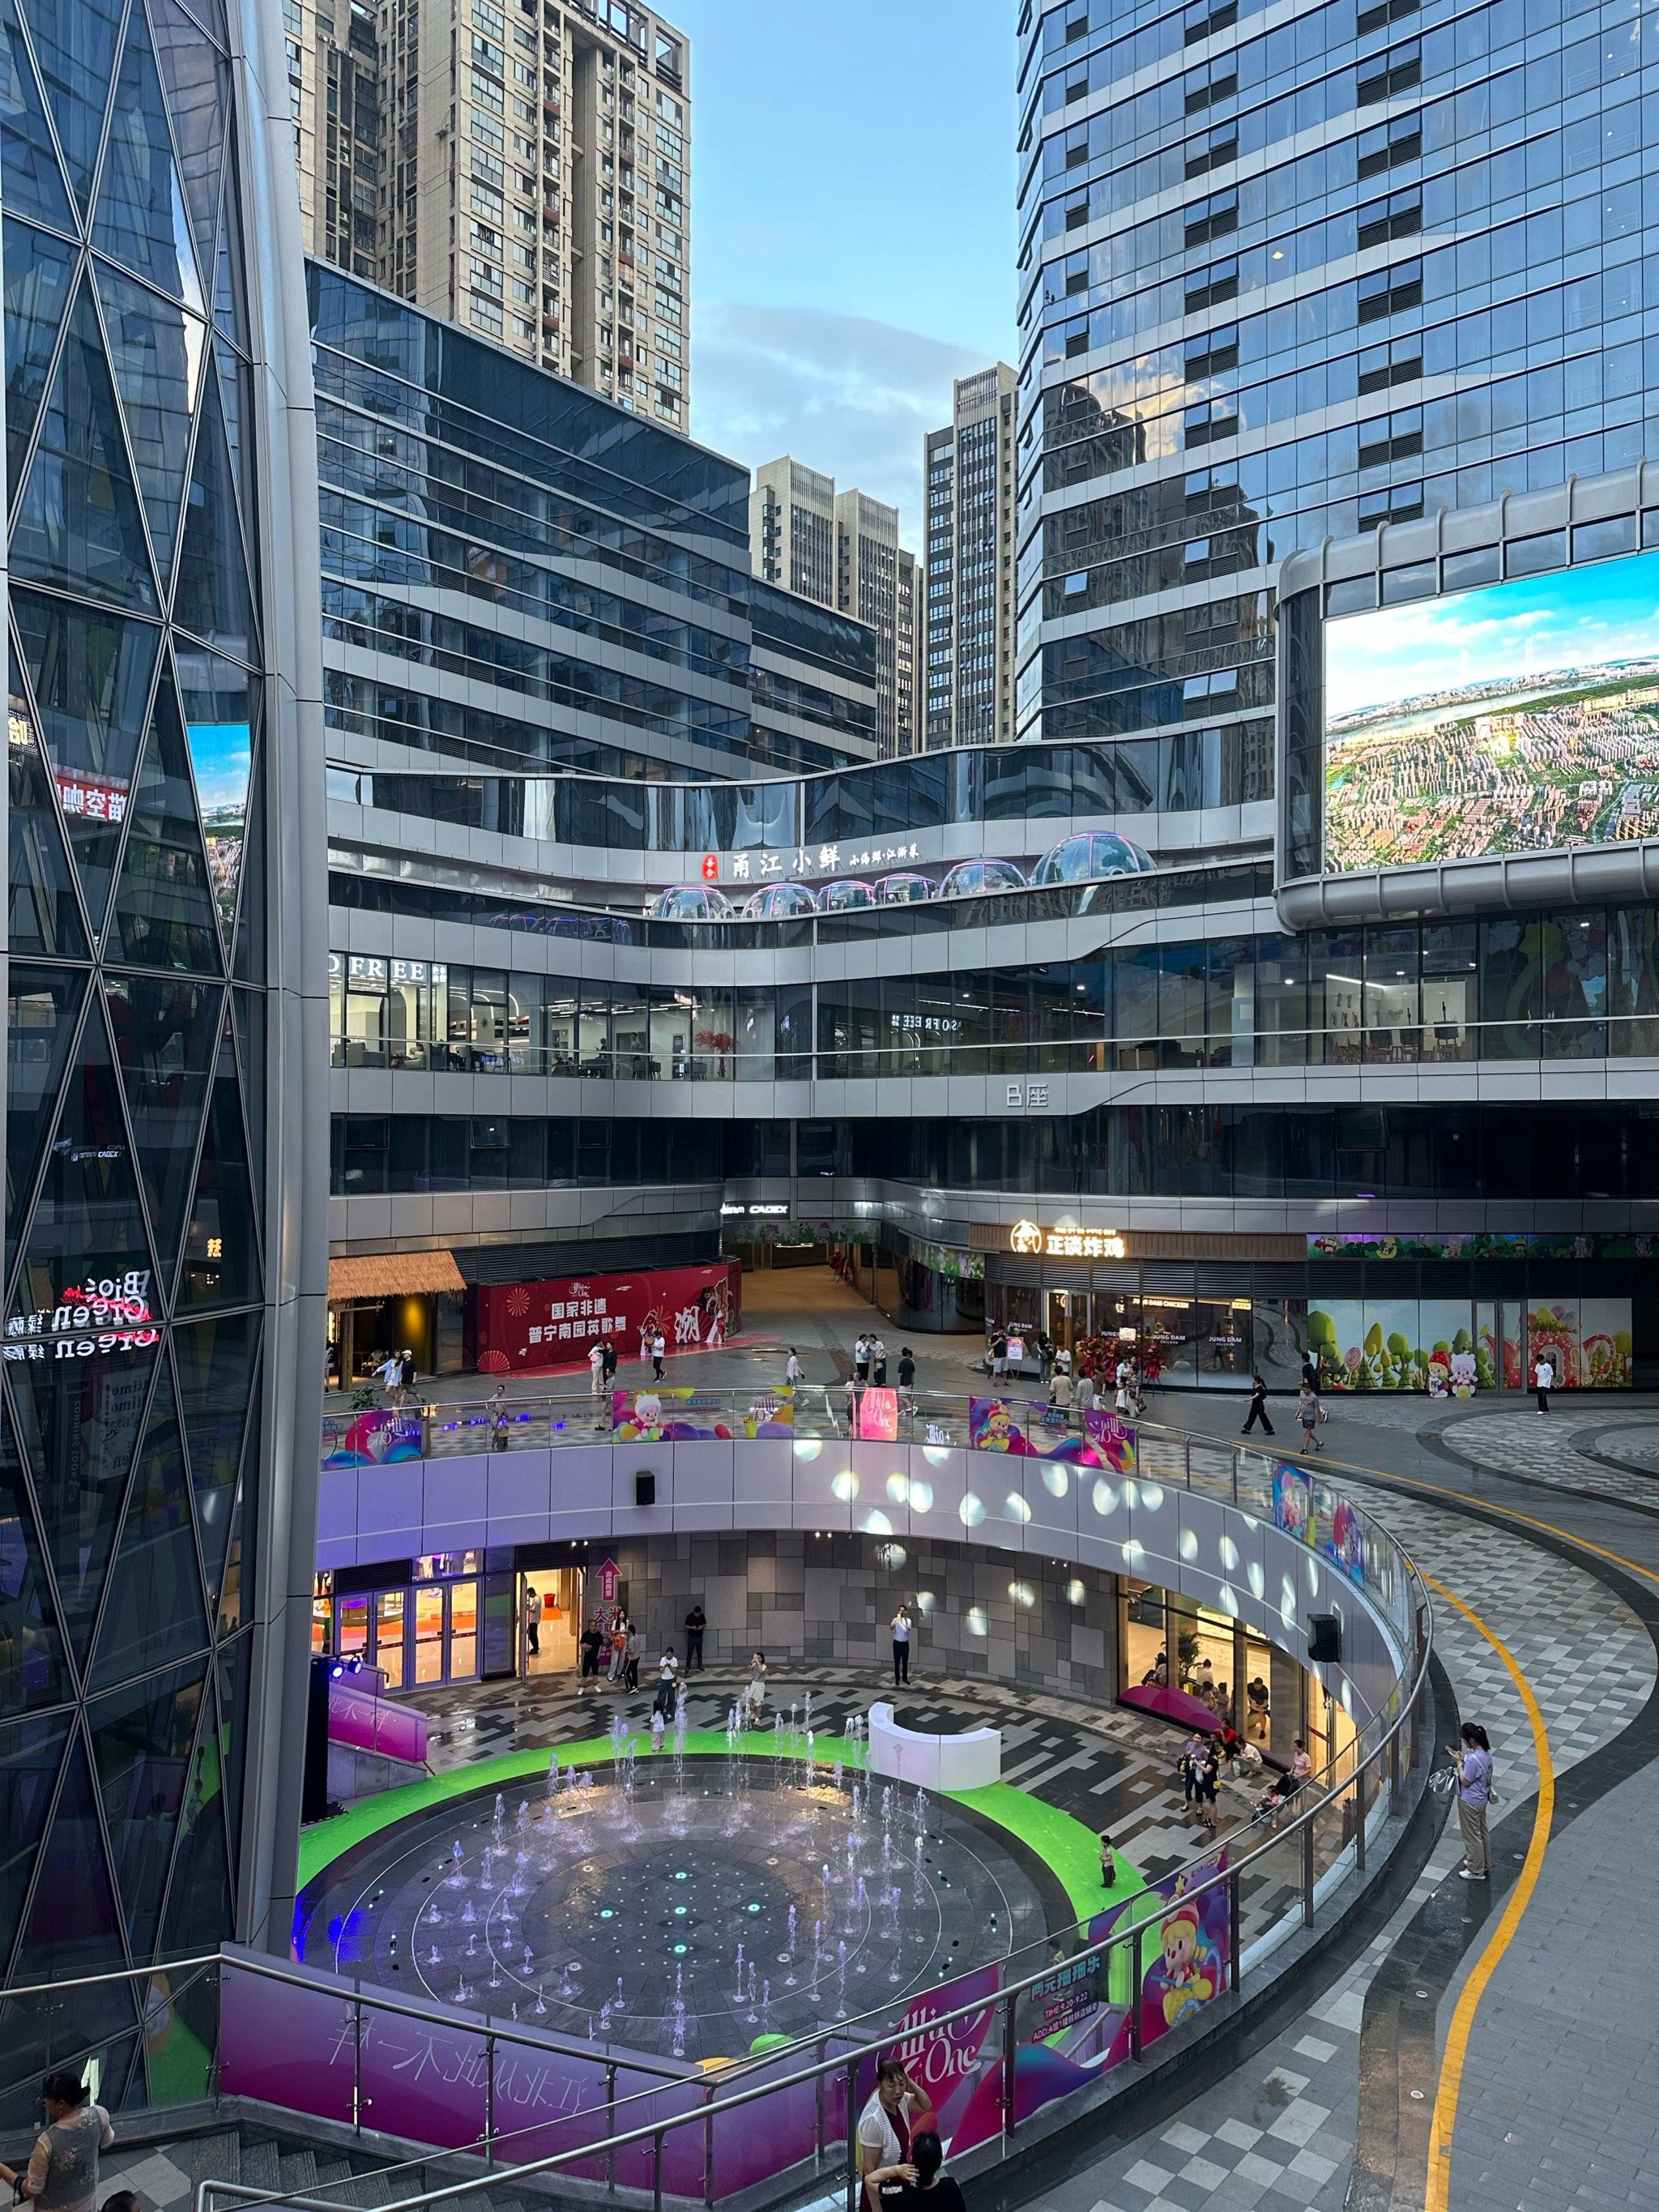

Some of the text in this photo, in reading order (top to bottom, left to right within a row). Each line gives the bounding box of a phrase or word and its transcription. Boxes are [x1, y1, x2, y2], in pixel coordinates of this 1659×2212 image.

[732, 844, 841, 878] 甬江小鲜
[1006, 1083, 1049, 1108] B座
[552, 1298, 607, 1320] 国家非遗
[528, 1316, 627, 1345] 普宁南园英歌舞
[593, 1607, 622, 1623] 大米
[925, 2037, 982, 2083] One
